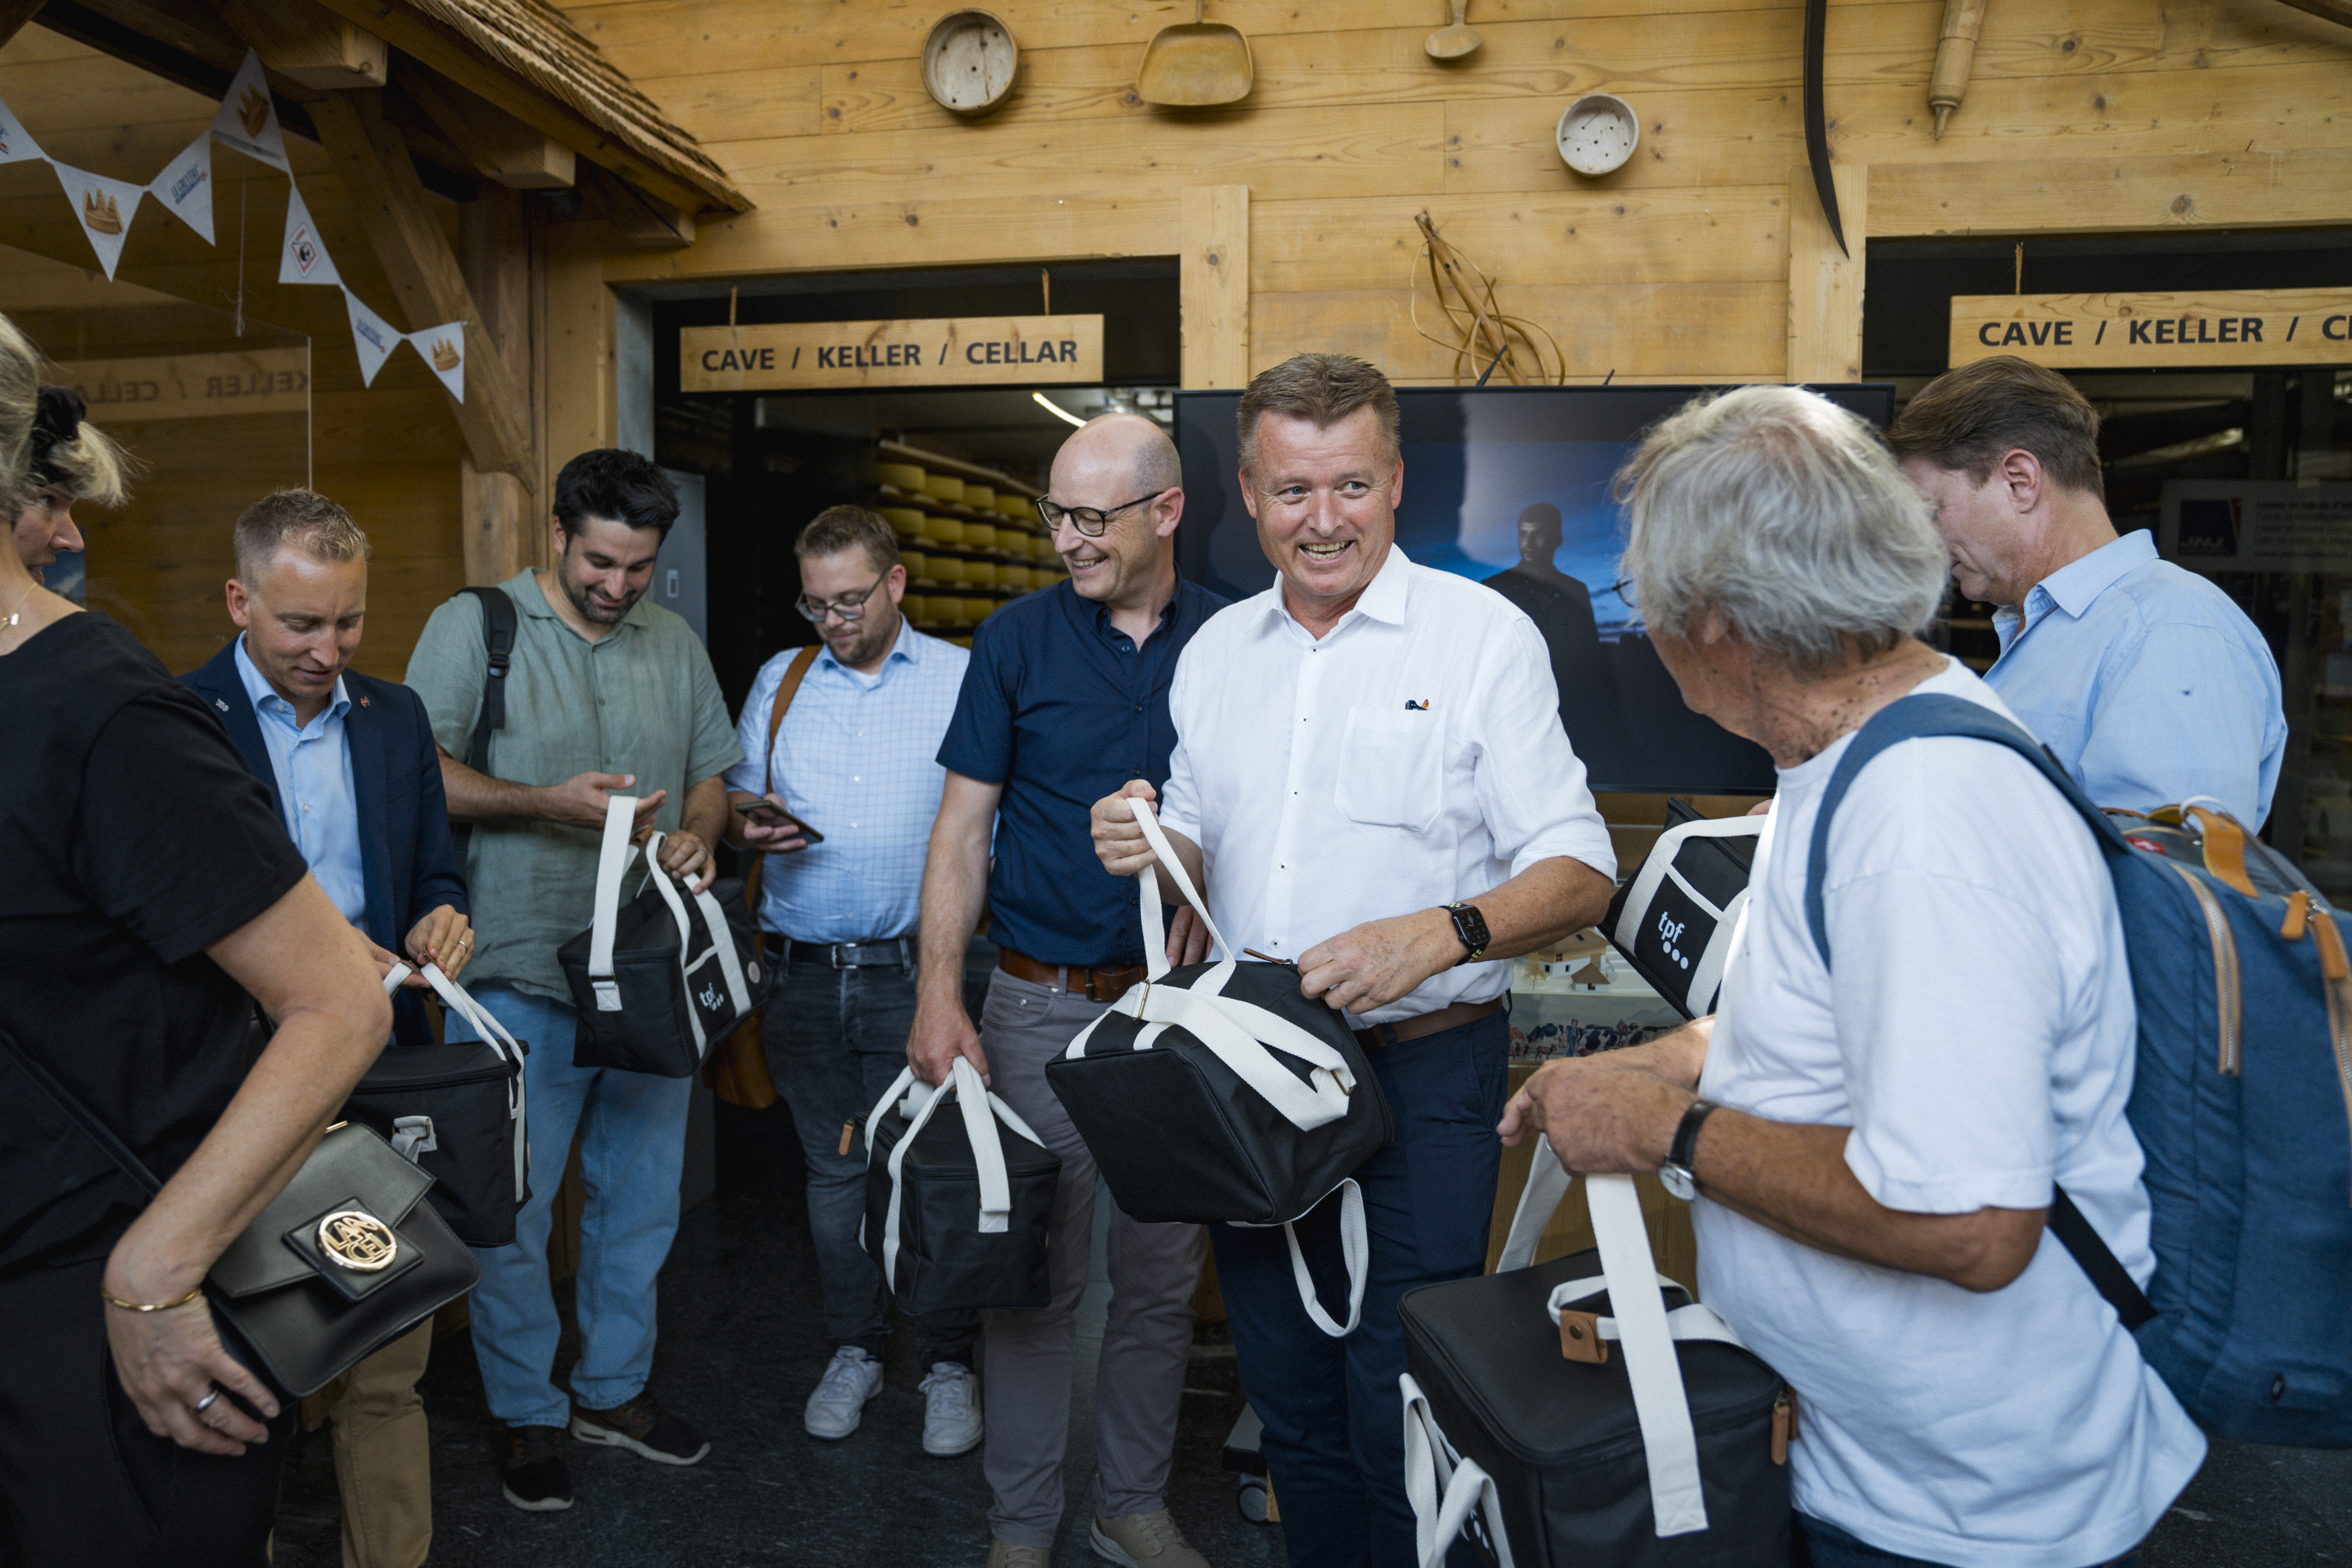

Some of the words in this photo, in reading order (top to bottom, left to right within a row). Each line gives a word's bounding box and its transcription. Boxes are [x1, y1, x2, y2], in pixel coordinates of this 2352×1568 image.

[1978, 321, 2074, 347] CAVE
[2129, 318, 2264, 345] KELLER
[2322, 315, 2352, 341] C
[701, 347, 775, 372] CAVE
[817, 345, 921, 369] KELLER
[965, 340, 1078, 365] CELLAR
[1658, 911, 1685, 944] tpf
[699, 982, 716, 1008] tpf
